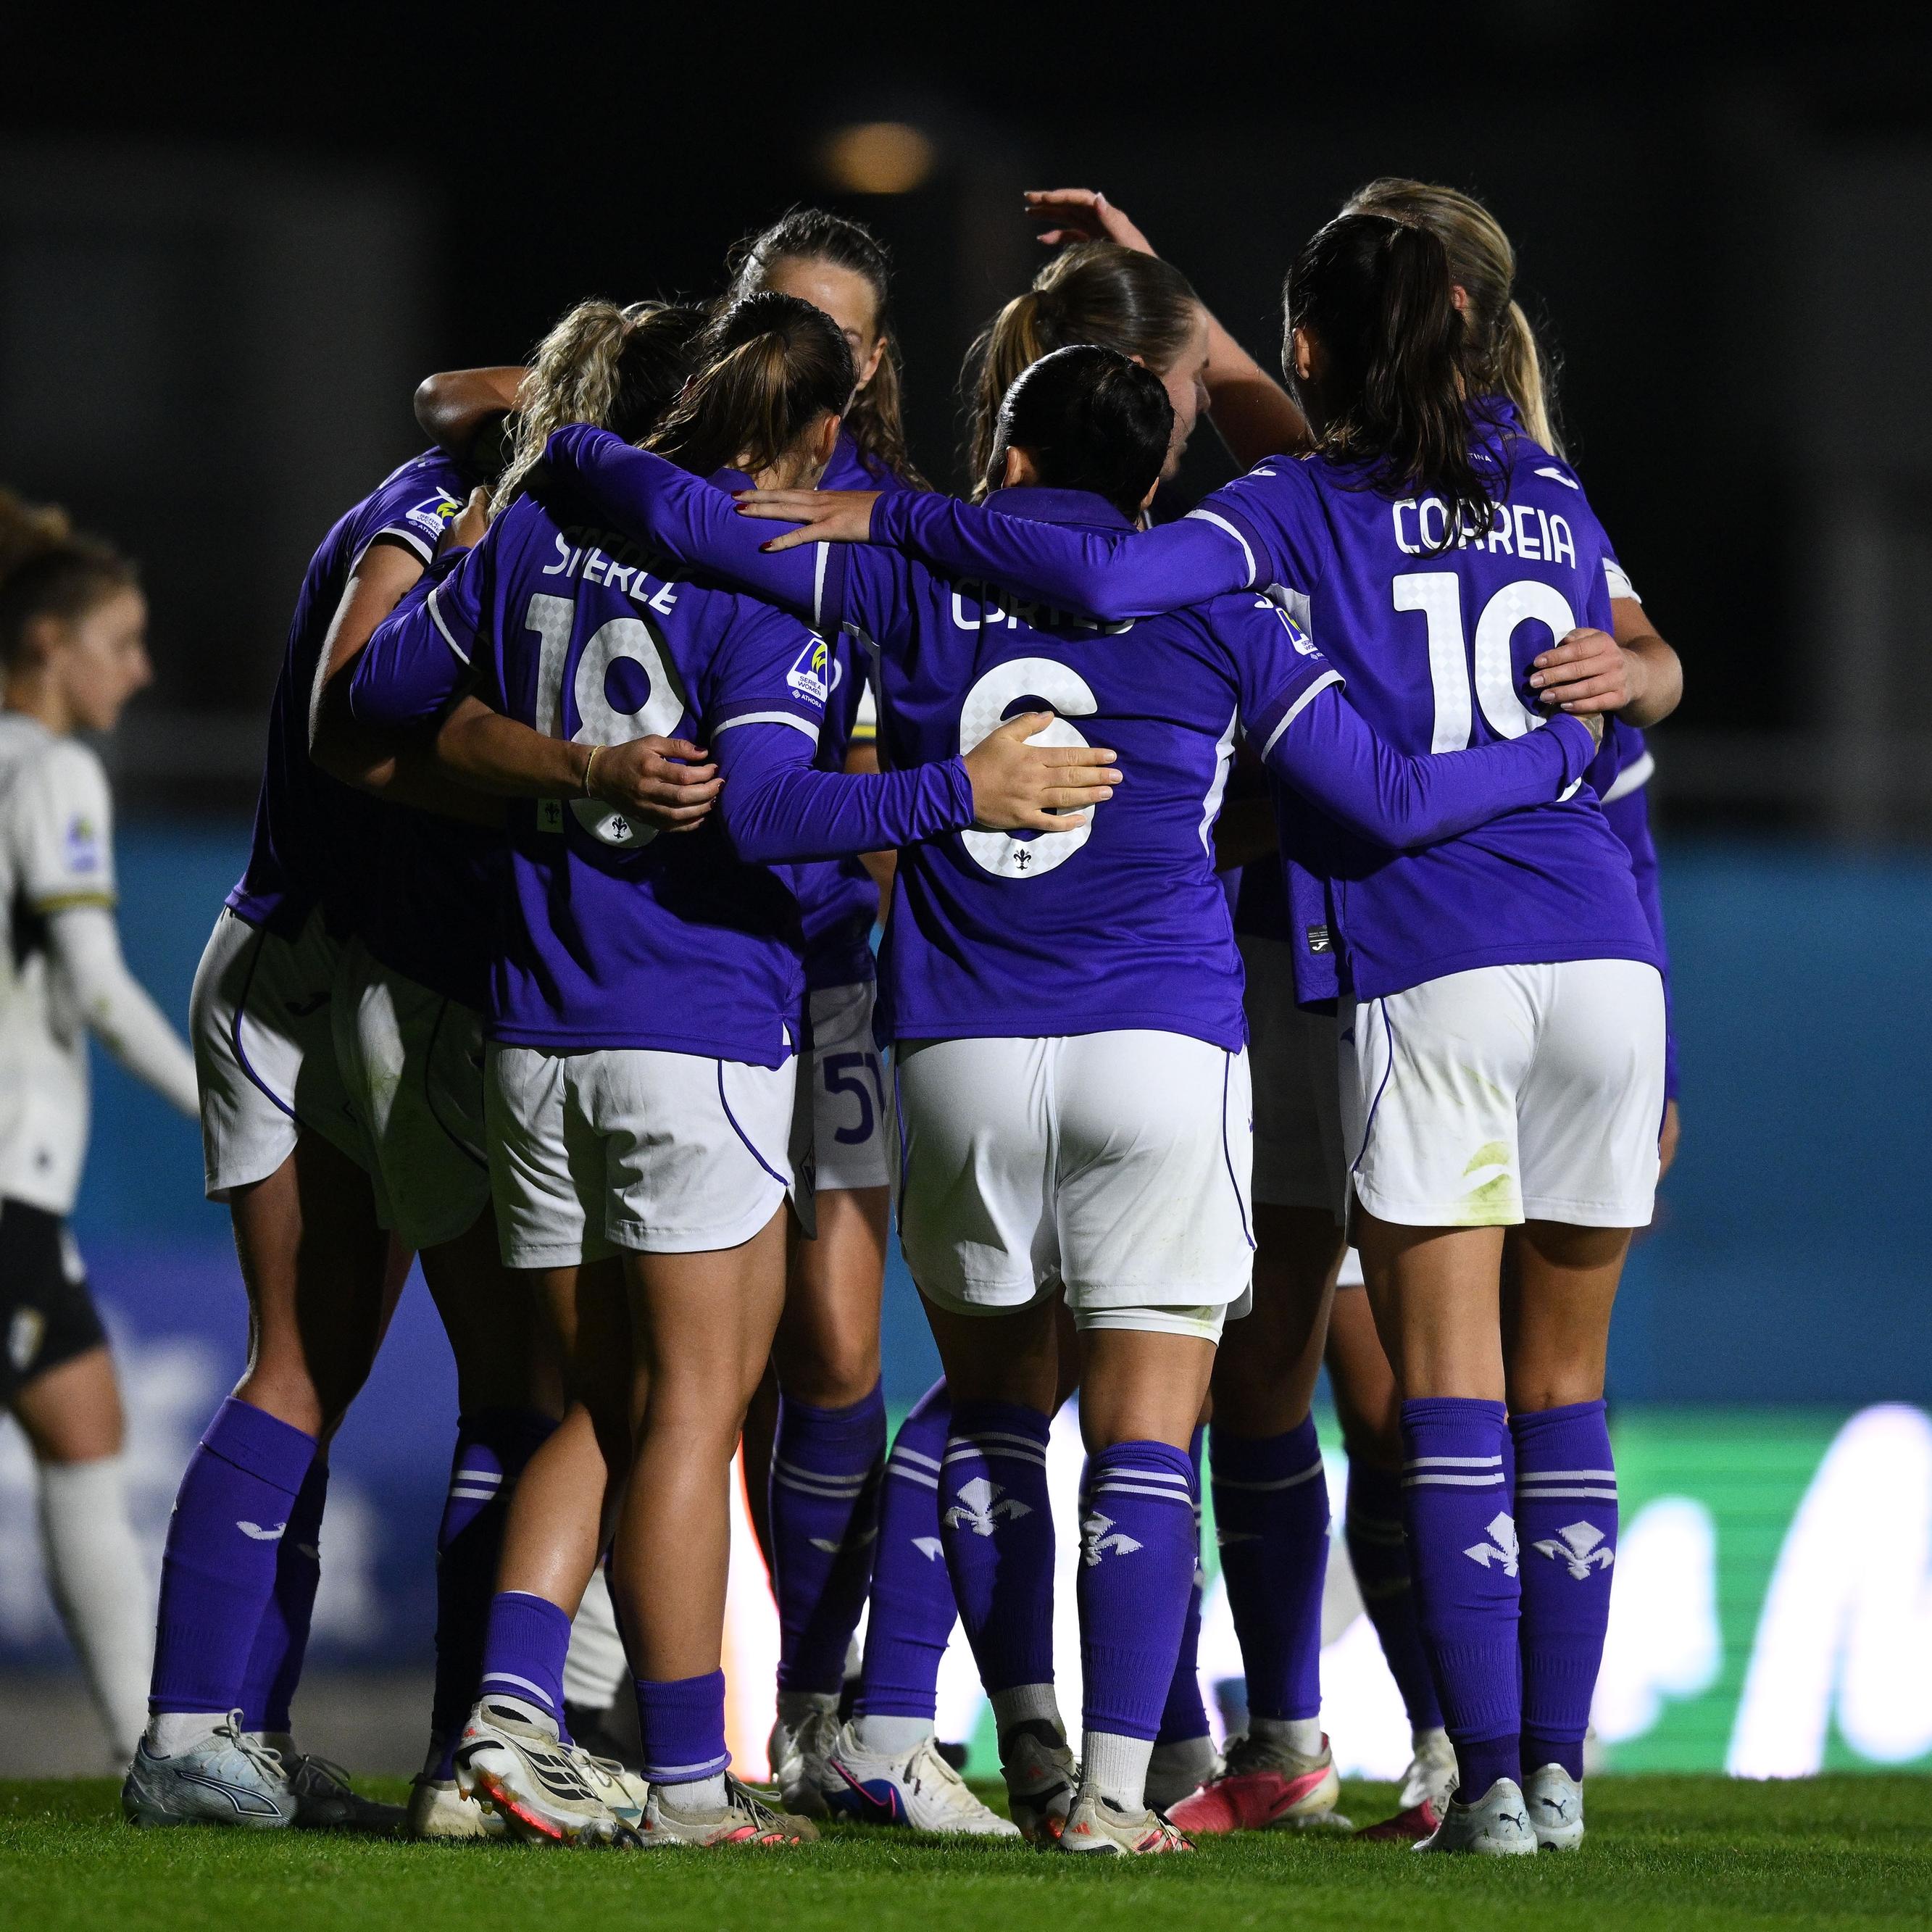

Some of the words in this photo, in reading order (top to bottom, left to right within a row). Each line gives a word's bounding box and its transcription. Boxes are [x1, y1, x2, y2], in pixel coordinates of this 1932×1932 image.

[525, 593, 686, 849] 18
[798, 680, 821, 696] WOMEN
[799, 675, 817, 688] SERIE
[801, 694, 823, 709] ATHORA
[1392, 571, 1581, 802] 10
[959, 657, 1098, 878] 6
